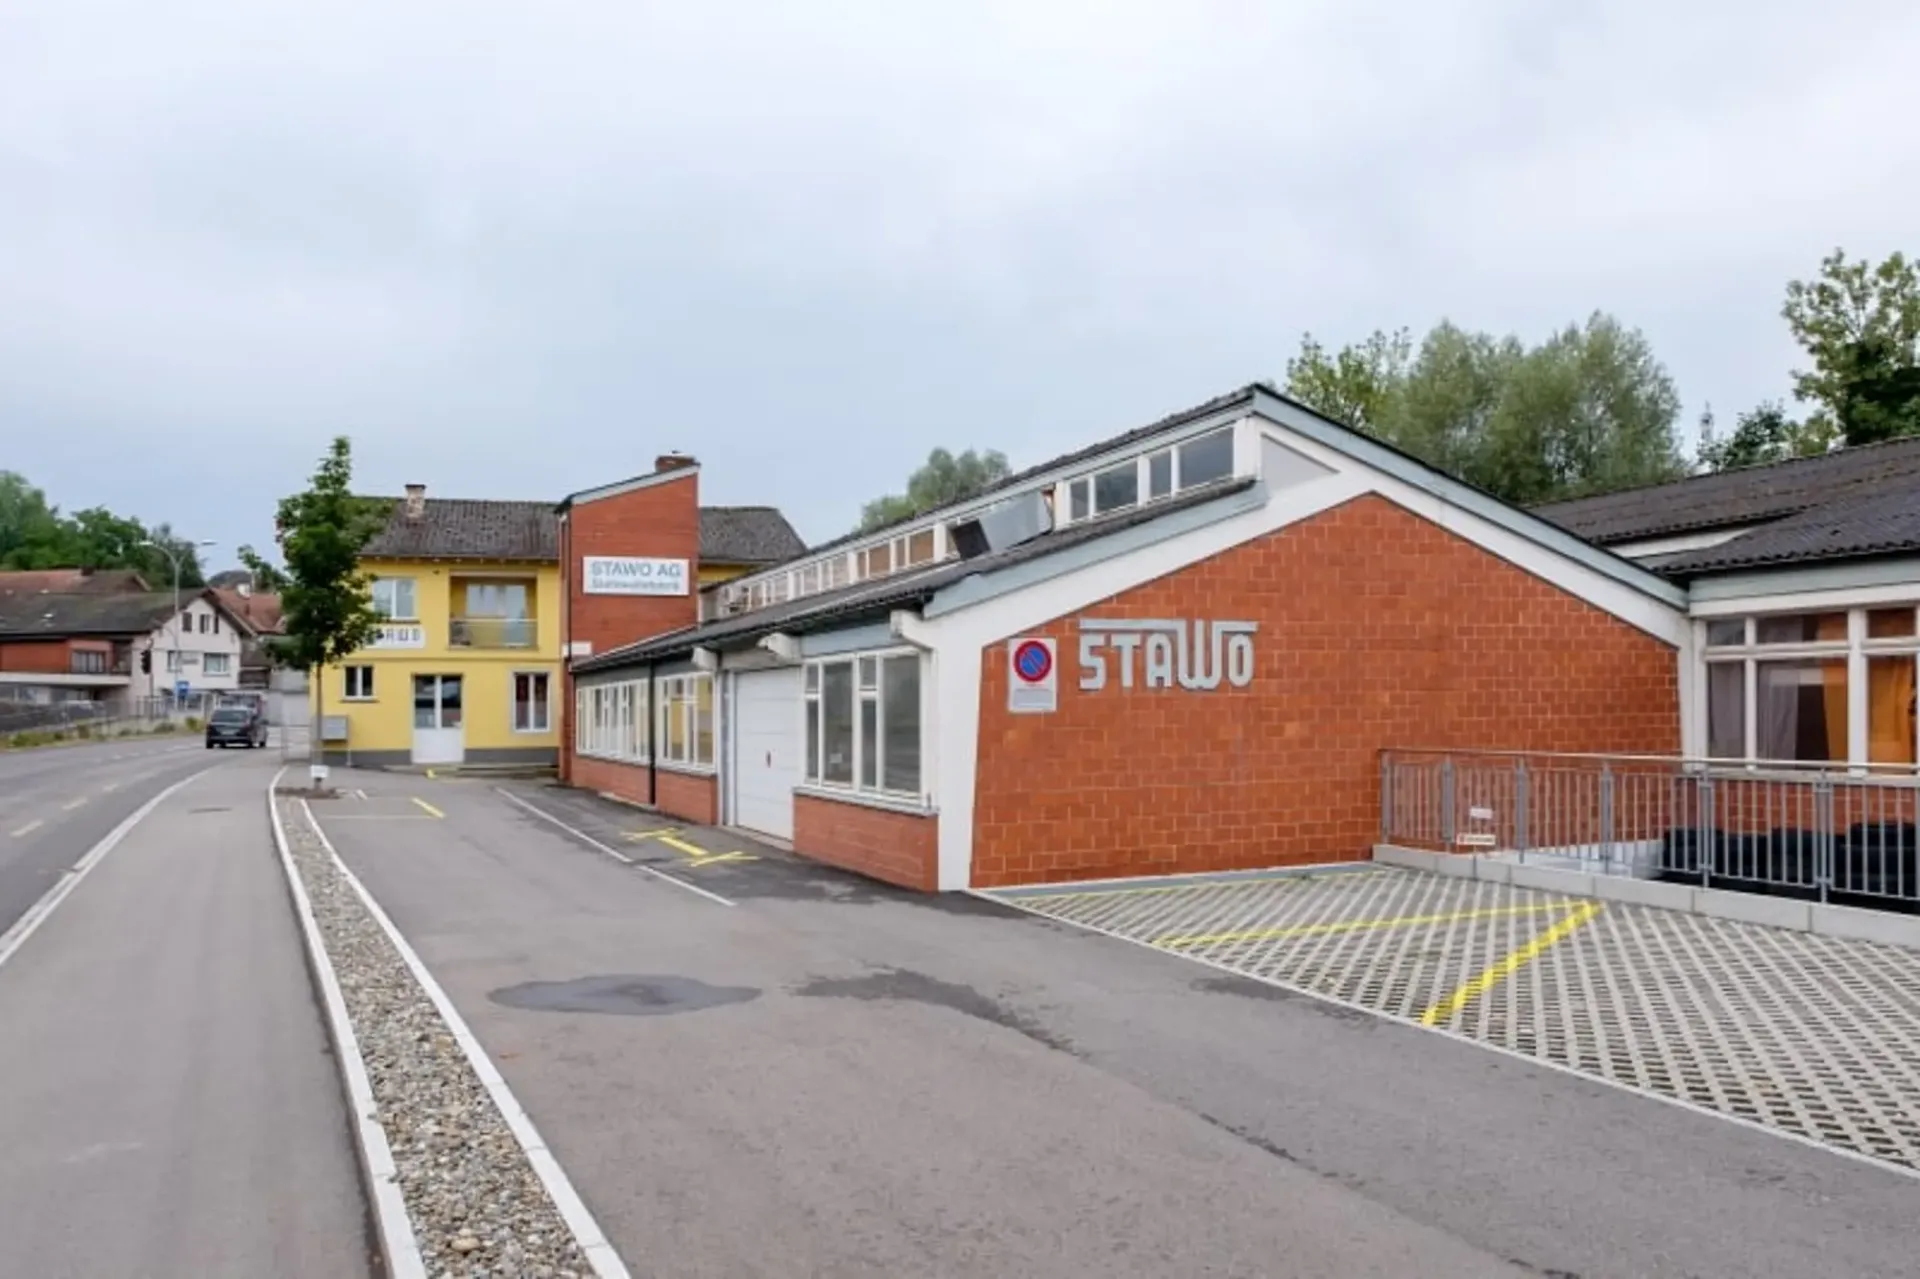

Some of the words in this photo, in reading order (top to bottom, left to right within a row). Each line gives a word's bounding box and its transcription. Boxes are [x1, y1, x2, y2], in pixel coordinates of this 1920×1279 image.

[592, 561, 651, 576] STAWO
[657, 563, 682, 577] AG
[1079, 618, 1259, 690] STAWO
